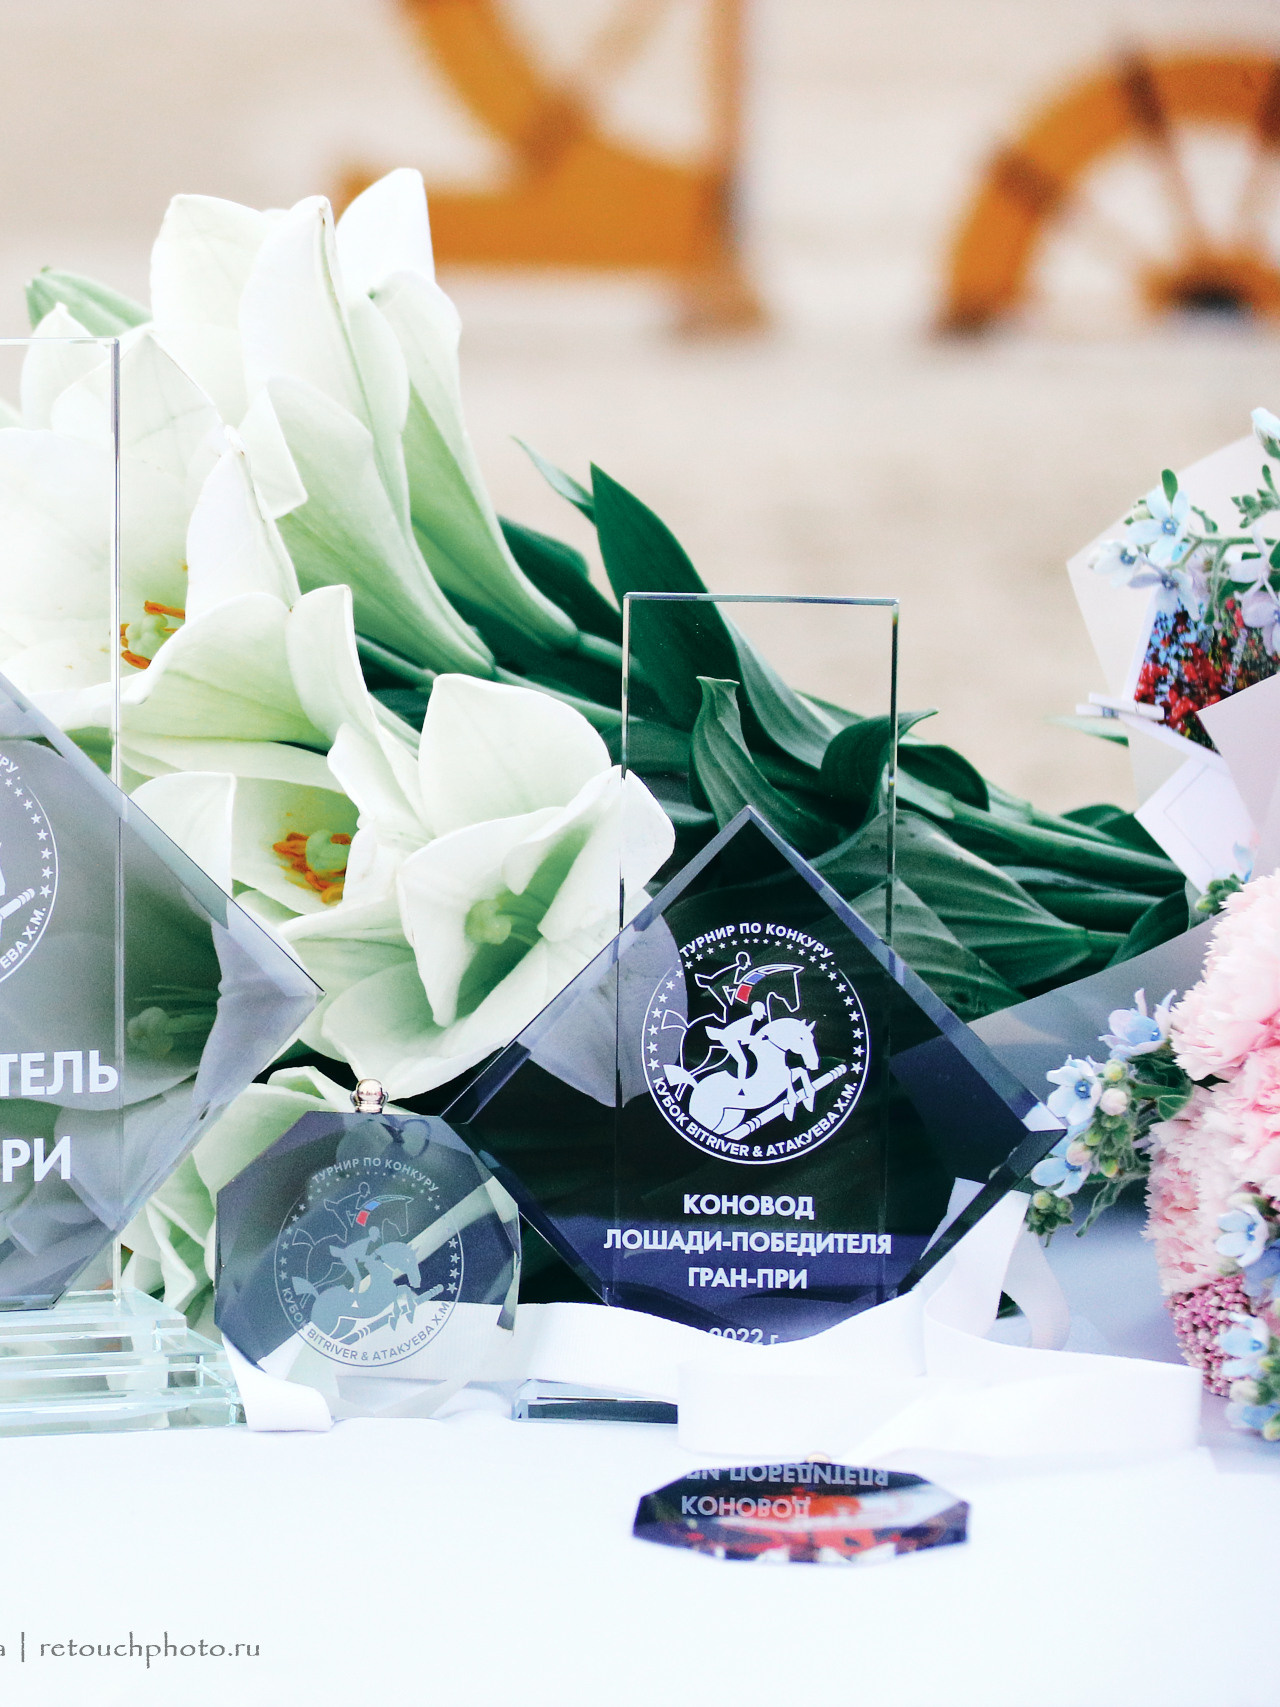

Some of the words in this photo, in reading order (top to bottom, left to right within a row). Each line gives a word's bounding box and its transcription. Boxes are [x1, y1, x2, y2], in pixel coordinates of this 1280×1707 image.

[679, 924, 736, 958] ТУРНИР
[739, 922, 762, 934] ПО
[766, 922, 833, 959] КОНКУРУ
[653, 1077, 691, 1128] КУБОК
[686, 1123, 750, 1157] BITRIVER
[752, 1145, 763, 1157] &
[766, 1112, 837, 1157] АТАКУЕВА
[312, 1157, 360, 1183] ТУРНИР
[363, 1157, 381, 1168] ПО
[384, 1158, 439, 1193] КОНКУРУ
[683, 1193, 815, 1220] КОНОВОД
[603, 1229, 892, 1257] ЛОШАДИ-ПОБЕДИТЕЛЯ
[688, 1267, 808, 1290] ГРАН-ПРИ
[307, 1327, 357, 1360] BITRIVER
[360, 1351, 369, 1361] &
[372, 1326, 435, 1361] АТАКУЕВА
